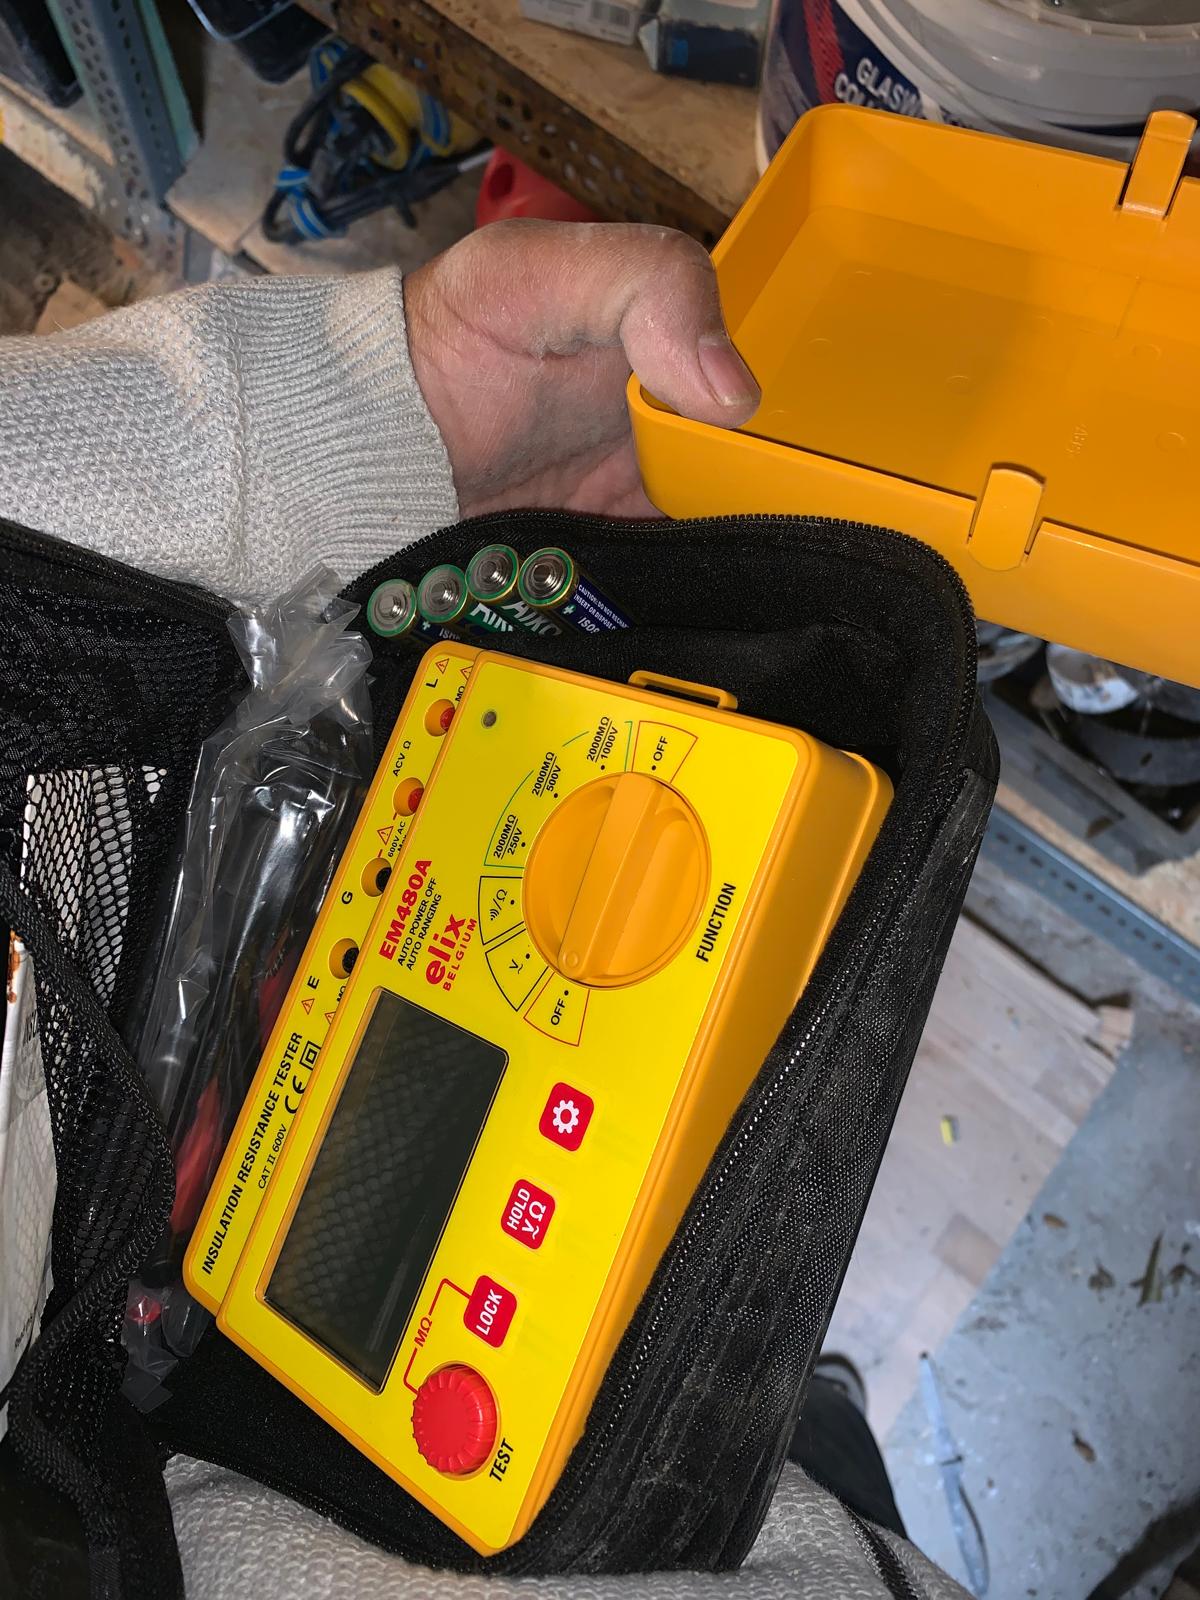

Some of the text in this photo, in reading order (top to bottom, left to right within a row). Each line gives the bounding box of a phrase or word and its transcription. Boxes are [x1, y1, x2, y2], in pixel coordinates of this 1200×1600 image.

[425, 678, 438, 688] L
[586, 716, 610, 762] 2000MΩ
[600, 727, 619, 760] 1000V
[653, 735, 669, 761] OFF
[392, 753, 406, 777] ACV
[531, 751, 555, 796] 2000MΩ
[546, 765, 562, 792] 500V
[387, 835, 399, 858] 600V
[397, 821, 406, 835] AC
[493, 814, 517, 859] 2000MΩ
[507, 828, 523, 856] 250V
[341, 890, 353, 905] G
[378, 860, 432, 960] EM480A
[397, 877, 437, 966] AUTO POWER OFF
[406, 894, 442, 971] AUTO RANGING
[695, 882, 737, 963] FUNCTION
[425, 914, 466, 985] elix
[443, 918, 477, 992] BELGIUM
[307, 975, 320, 990] E
[550, 998, 566, 1026] OFF
[201, 1032, 303, 1275] INSULATION RESISTANCE TESTER
[258, 1165, 271, 1189] CAT
[272, 1123, 287, 1153] 600V
[506, 1188, 531, 1231] HOLD
[414, 1316, 433, 1348] MΩ
[476, 1288, 503, 1336] LOCK
[489, 1437, 514, 1483] TEST
